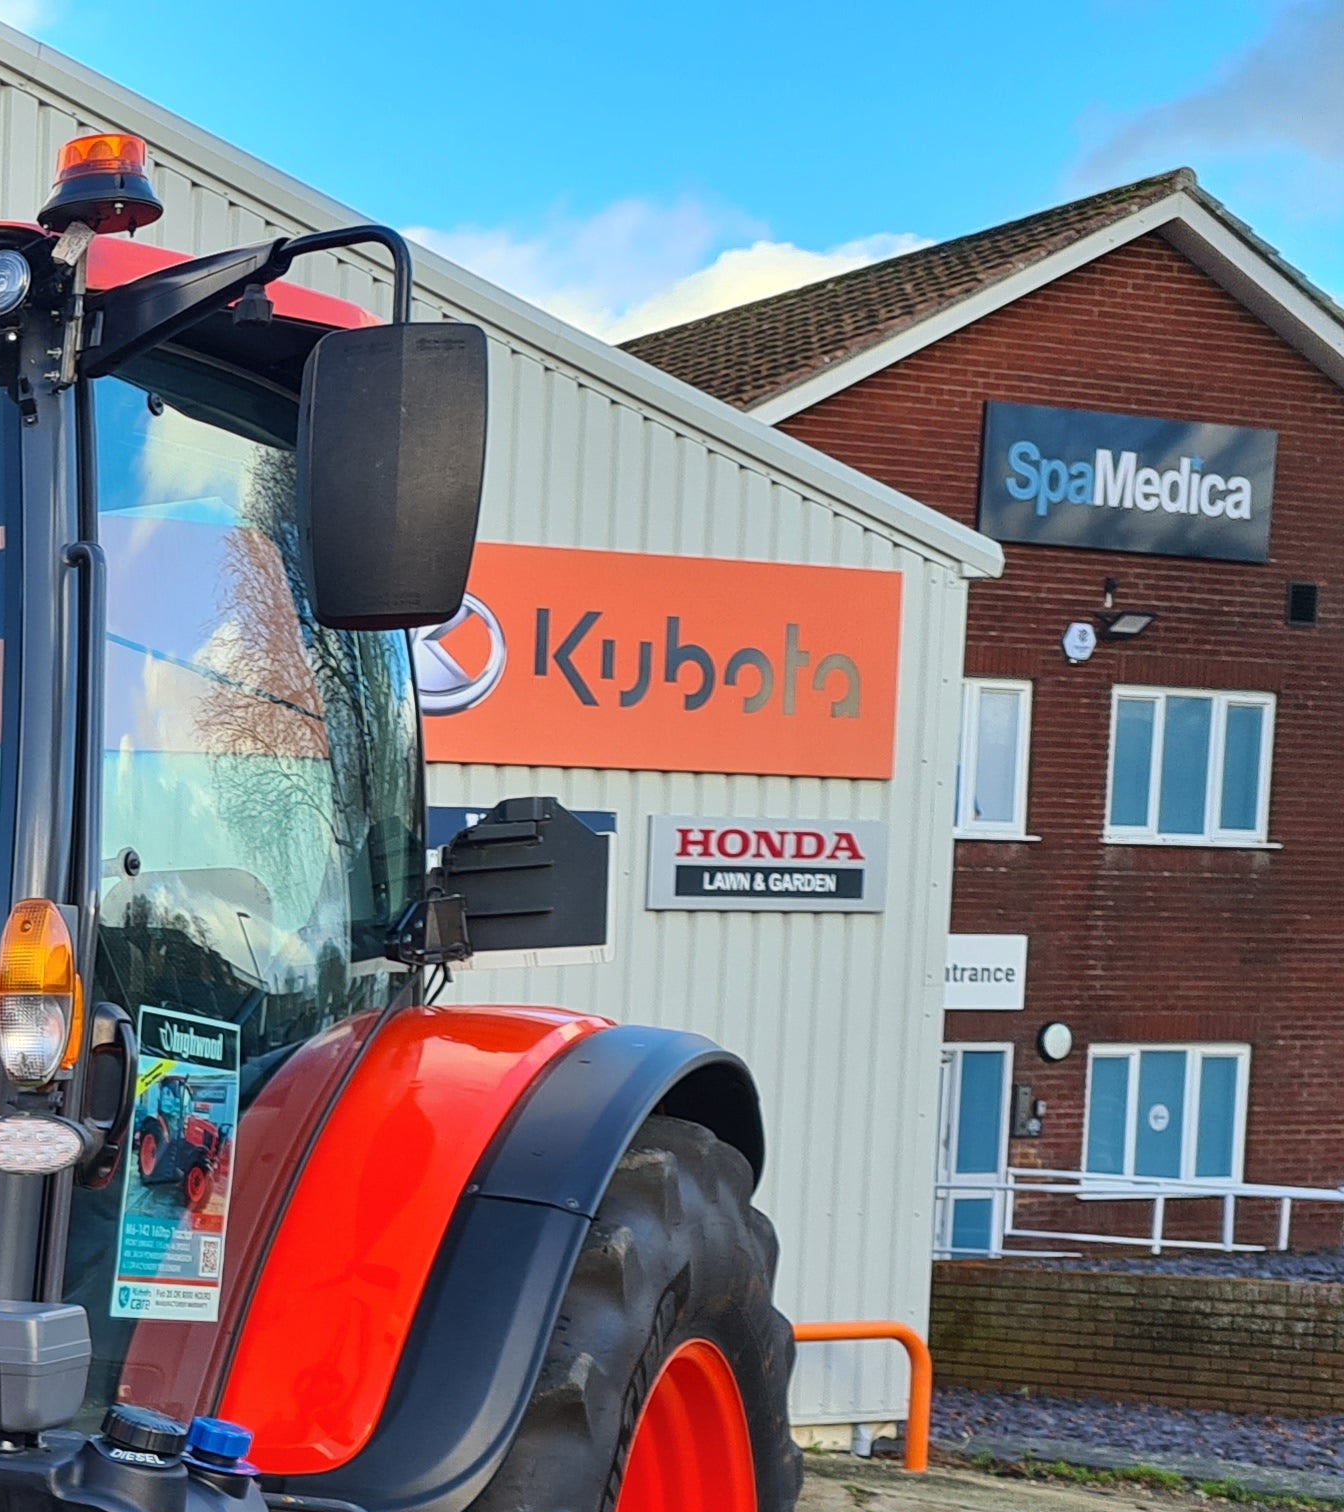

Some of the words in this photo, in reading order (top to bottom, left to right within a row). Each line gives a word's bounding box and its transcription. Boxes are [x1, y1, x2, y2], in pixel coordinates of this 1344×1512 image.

[1005, 441, 1251, 520] SpaMedica
[534, 607, 861, 719] Kubota
[675, 828, 865, 860] HONDA
[703, 871, 750, 890] LAWN
[753, 872, 766, 890] &
[768, 873, 837, 892] GARDEN
[945, 963, 1016, 983] trance
[173, 1023, 224, 1061] highwood
[109, 1448, 166, 1465] DIESEL
